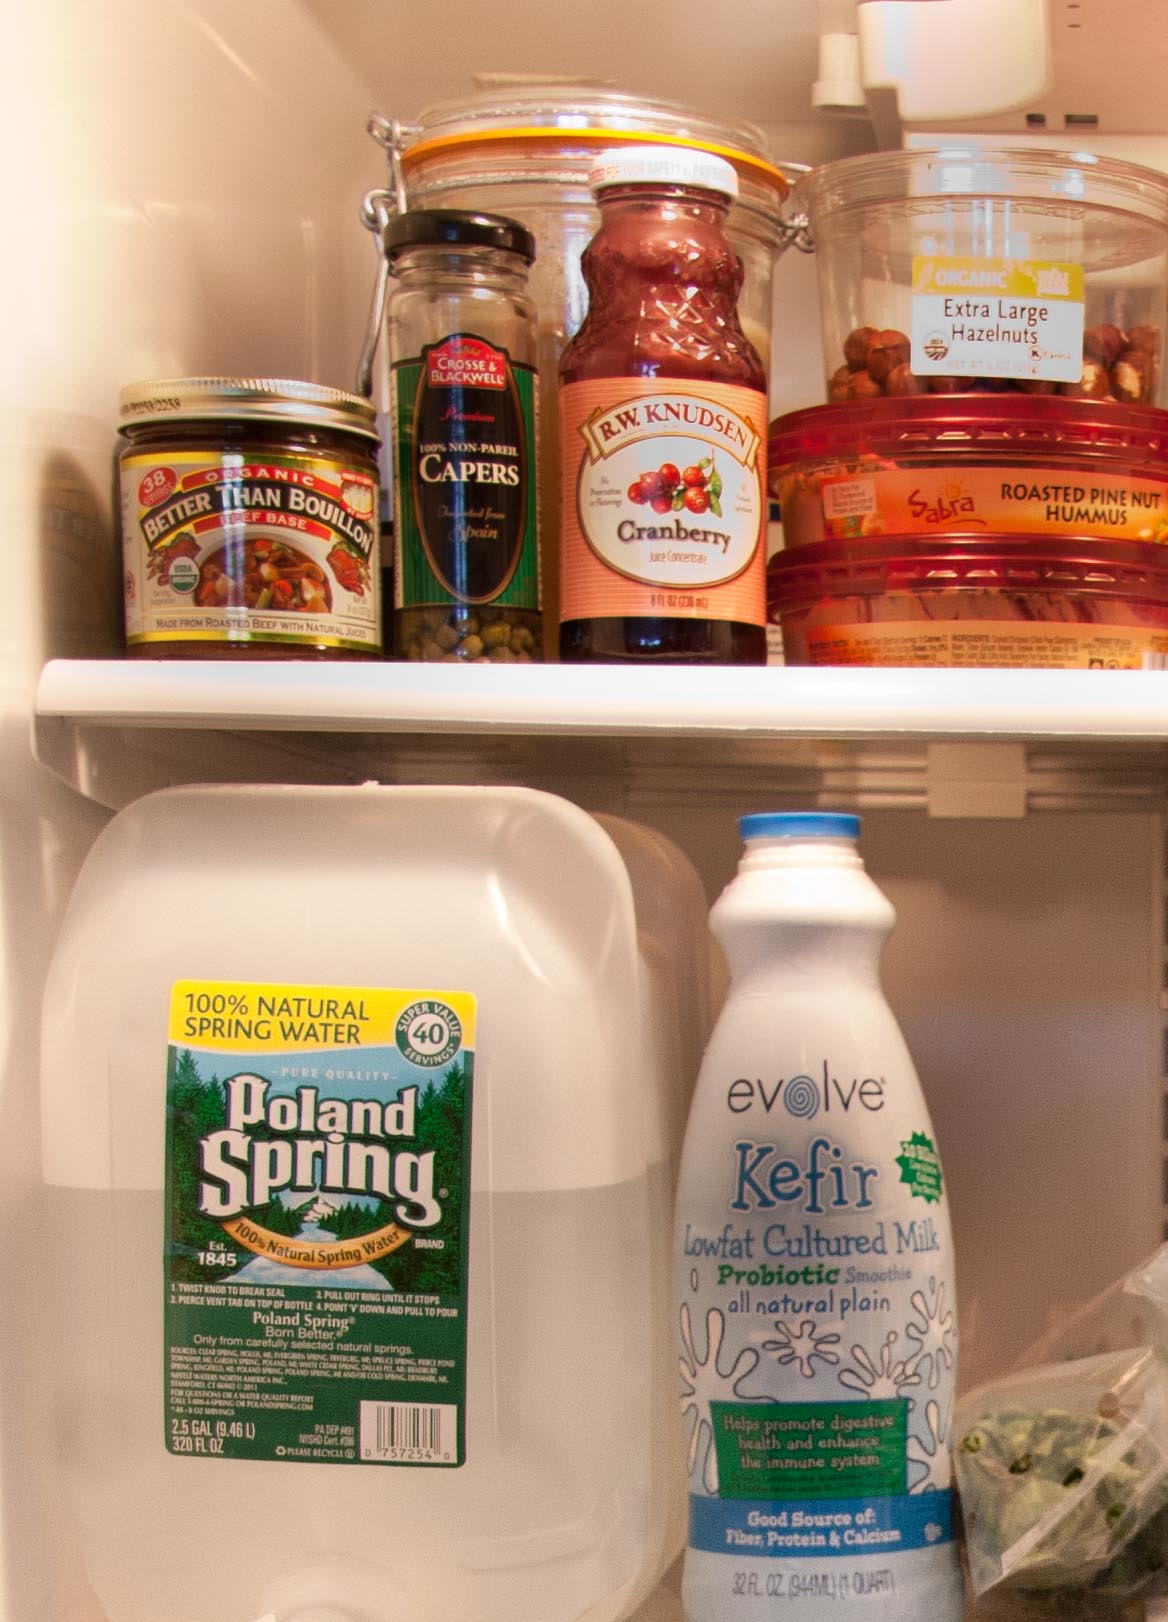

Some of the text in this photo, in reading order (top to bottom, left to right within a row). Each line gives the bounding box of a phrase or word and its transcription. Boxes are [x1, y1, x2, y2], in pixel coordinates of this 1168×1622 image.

[935, 267, 1008, 288] ORGANIC
[944, 298, 1048, 327] Extra Large
[951, 323, 1038, 345] Hazelnuts
[437, 357, 497, 372] CROSSE &
[430, 370, 504, 385] BLACKWELL
[599, 402, 748, 449] R.W. KNUDSEN
[143, 468, 167, 495] 38
[204, 465, 317, 488] ORGANIC
[419, 454, 520, 486] CAPERS
[906, 488, 976, 526] Sabra
[1000, 482, 1163, 510] ROASTED PINE NUT
[143, 483, 373, 555] BETTER THAN BOUILLON
[220, 510, 308, 532] BEEF BASE
[1045, 504, 1128, 526] HUMMUS
[616, 519, 732, 555] Cranberry
[184, 992, 370, 1021] 100% NATURAL
[184, 1017, 362, 1045] SPRING WATER
[398, 1001, 462, 1039] SUPER VALUE
[411, 1023, 445, 1046] 40
[401, 1041, 454, 1068] SERVINGS
[281, 1066, 392, 1081] PURE QUALITY
[727, 1060, 885, 1120] evolve
[224, 1073, 419, 1138] Poland
[198, 1129, 444, 1230] Spring
[730, 1138, 879, 1214] Kefir
[208, 1240, 228, 1252] Est.
[233, 1219, 402, 1266] 100% Natural Spring Water
[414, 1238, 445, 1250] BRAND
[684, 1218, 941, 1259] Lowfat Cultured Milk
[197, 1251, 238, 1268] 1845
[716, 1263, 913, 1287] Probiotic Smoothie
[727, 1286, 891, 1321] all natural plain
[253, 1311, 349, 1332] Poland Spring
[193, 1334, 415, 1356] Only from carefully selected natural springs.
[266, 1326, 336, 1341] Born Better.
[172, 1419, 256, 1440] 2.5 GAL (9.46 L)
[723, 1412, 895, 1433] Helps promote digestive
[172, 1436, 225, 1454] 320 FL OZ
[737, 1434, 880, 1451] health and enhance
[740, 1454, 881, 1471] the immune system
[747, 1507, 877, 1529] Good Source of:
[725, 1526, 902, 1551] Fiber, Protein & Calcium
